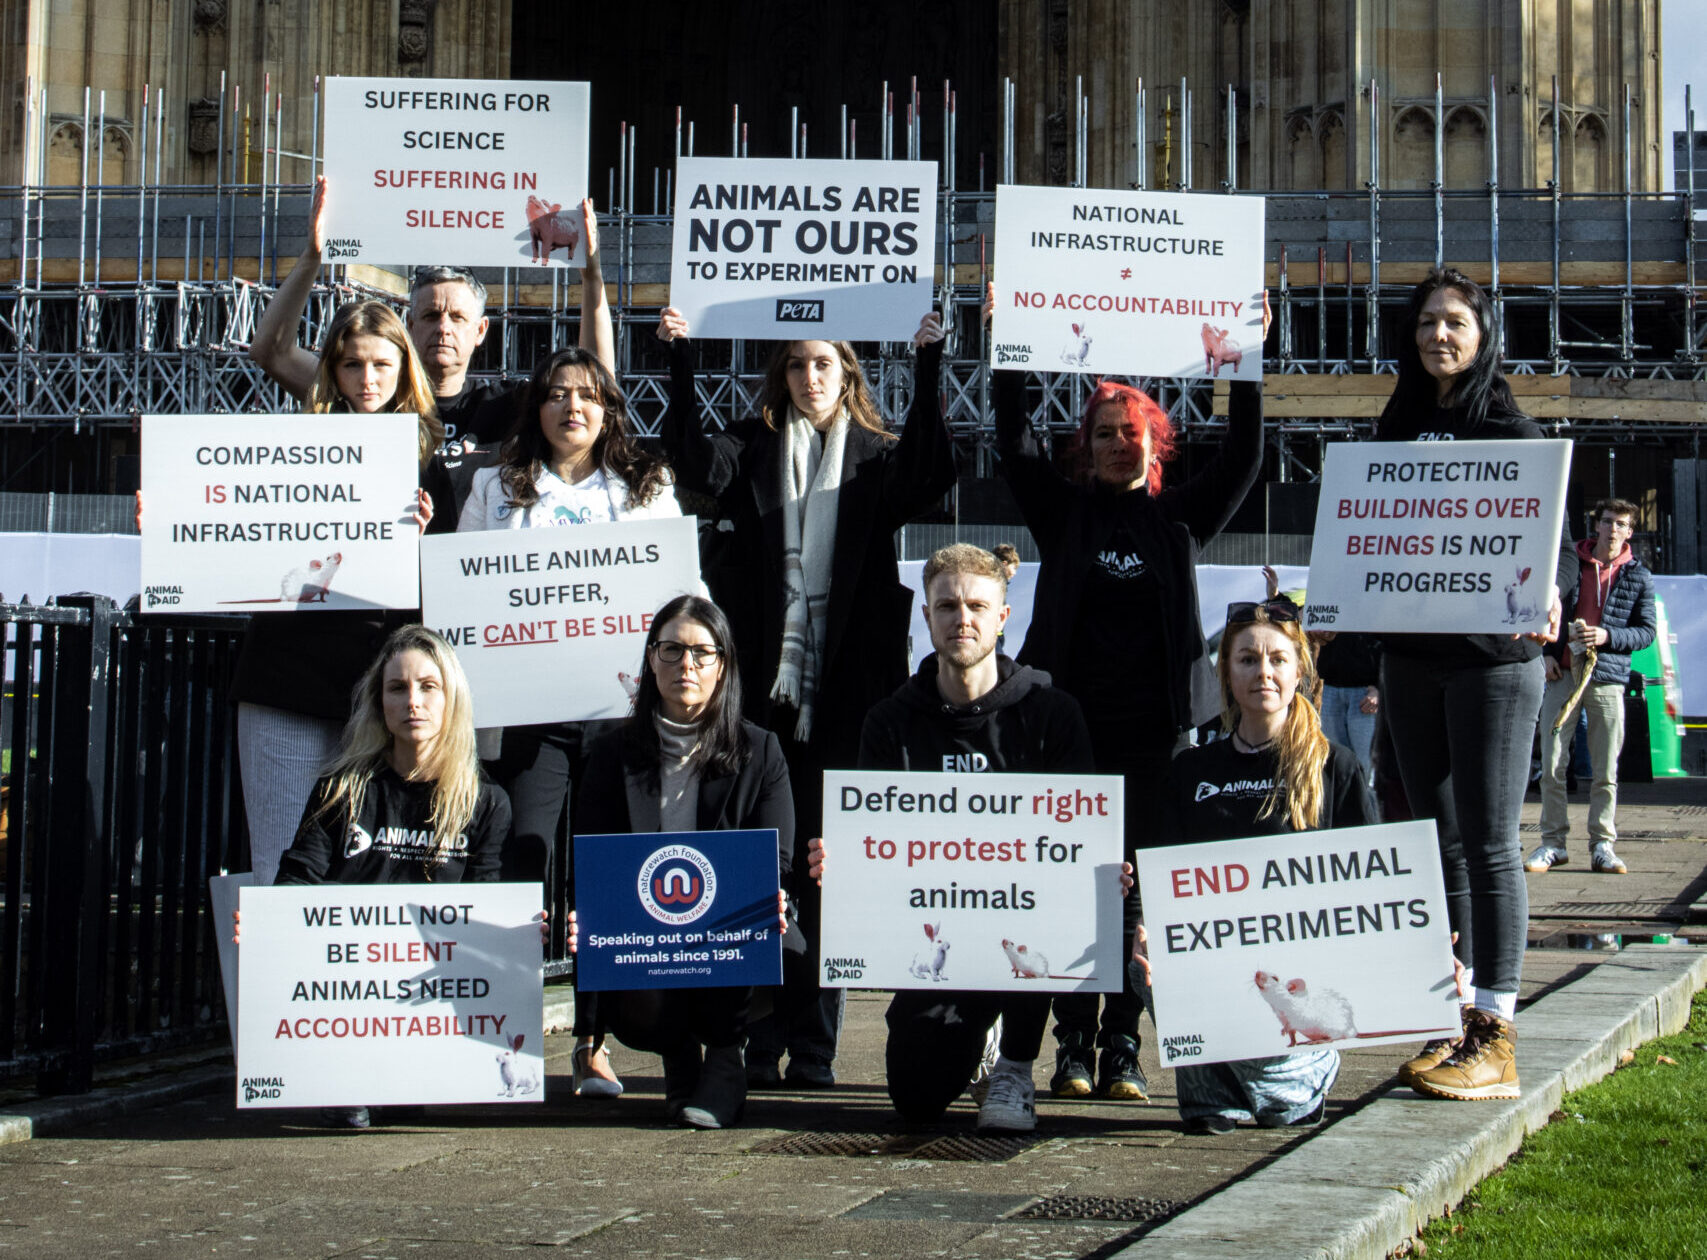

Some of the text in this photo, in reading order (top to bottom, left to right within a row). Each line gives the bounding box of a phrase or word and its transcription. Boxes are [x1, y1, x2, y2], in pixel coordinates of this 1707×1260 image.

[365, 91, 550, 112] SUFFERING FOR
[404, 131, 504, 150] SCIENCE
[374, 170, 536, 190] SUFFERING IN
[689, 184, 920, 213] ANIMALS ARE
[406, 210, 504, 228] SILENCE
[1073, 205, 1183, 225] NATIONAL
[325, 238, 362, 248] ANIMAL
[689, 219, 918, 256] NOT OURS
[1032, 232, 1223, 255] INFRASTRUCTURE
[341, 248, 358, 257] AID
[687, 262, 916, 283] TO EXPERIMENT ON
[1015, 292, 1243, 317] NO ACCOUNTABILITY
[995, 343, 1032, 353] ANIMAL
[1012, 354, 1029, 363] AID
[197, 446, 362, 465] COMPASSION
[1367, 461, 1519, 482] PROTECTING
[206, 484, 361, 503] IS NATIONAL
[1338, 498, 1540, 519] BUILDINGS OVER
[174, 522, 392, 542] INFRASTRUCTURE
[1347, 535, 1522, 555] BEINGS IS NOT
[460, 544, 659, 576] WHILE ANIMALS
[145, 586, 183, 594] ANIMAL
[1365, 572, 1491, 593] PROGRESS
[162, 595, 180, 604] AID
[509, 583, 608, 607] SUFFER,
[1306, 606, 1340, 614] ANIMAL
[1321, 615, 1335, 624] AID
[439, 613, 654, 647] WE CAN'T BE SILE
[943, 753, 987, 772] END
[1222, 779, 1274, 792] ANIMAL
[841, 786, 1108, 823] Defend our right
[374, 826, 436, 847] ANIMAL
[863, 836, 1083, 867] to protest for
[641, 847, 713, 893] naturewatch foundation
[1171, 847, 1411, 898] END ANIMAL
[910, 882, 1035, 910] animals
[303, 905, 473, 926] WE WILL NOT
[648, 902, 708, 922] ANIMAL WELFARE
[1166, 899, 1429, 953] EXPERIMENTS
[589, 929, 769, 948] Speaking out on behalf of
[328, 941, 457, 963] BE SILENT
[615, 950, 744, 964] animals since 1991.
[648, 966, 711, 975] naturewatch.org
[824, 958, 866, 968] ANIMAL
[843, 968, 862, 978] AID
[292, 979, 490, 1001] ANIMALS NEED
[275, 1015, 506, 1039] ACCOUNTABILITY
[1162, 1034, 1205, 1048] ANIMAL
[1182, 1047, 1202, 1056] AID
[242, 1078, 285, 1088] ANIMAL
[261, 1089, 281, 1099] AID
